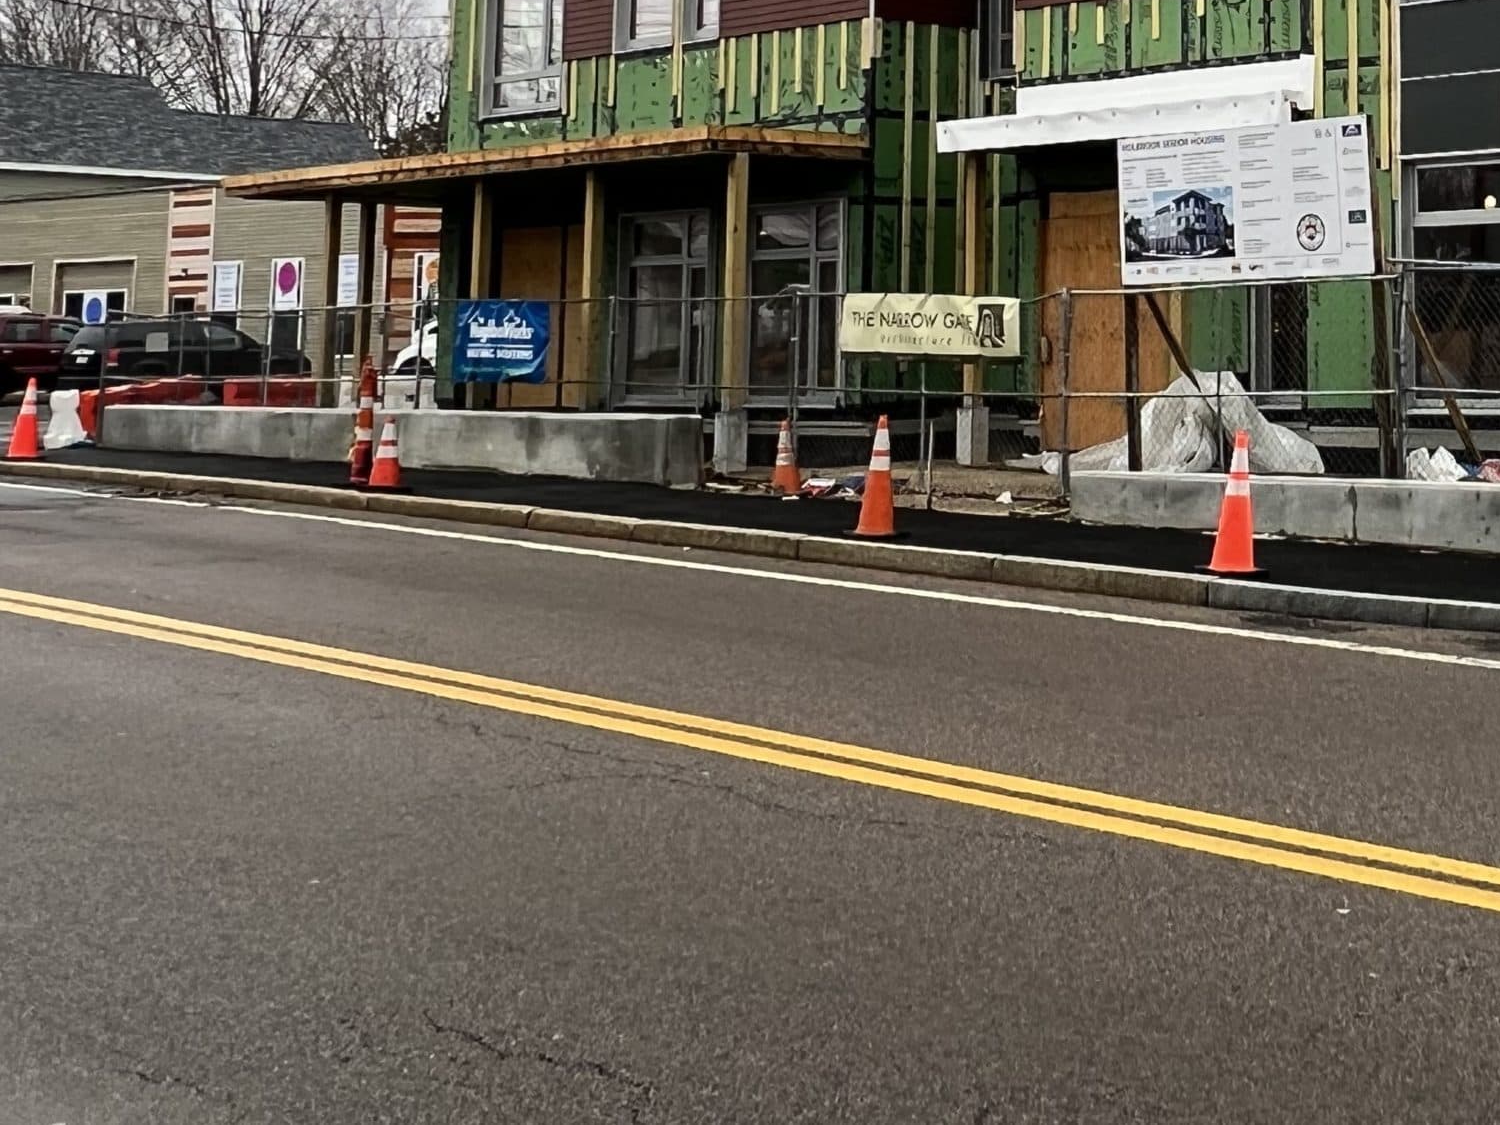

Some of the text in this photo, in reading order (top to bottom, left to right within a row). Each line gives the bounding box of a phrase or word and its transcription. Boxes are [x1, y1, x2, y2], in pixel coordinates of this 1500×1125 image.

[851, 311, 975, 330] THE NARROW GATE
